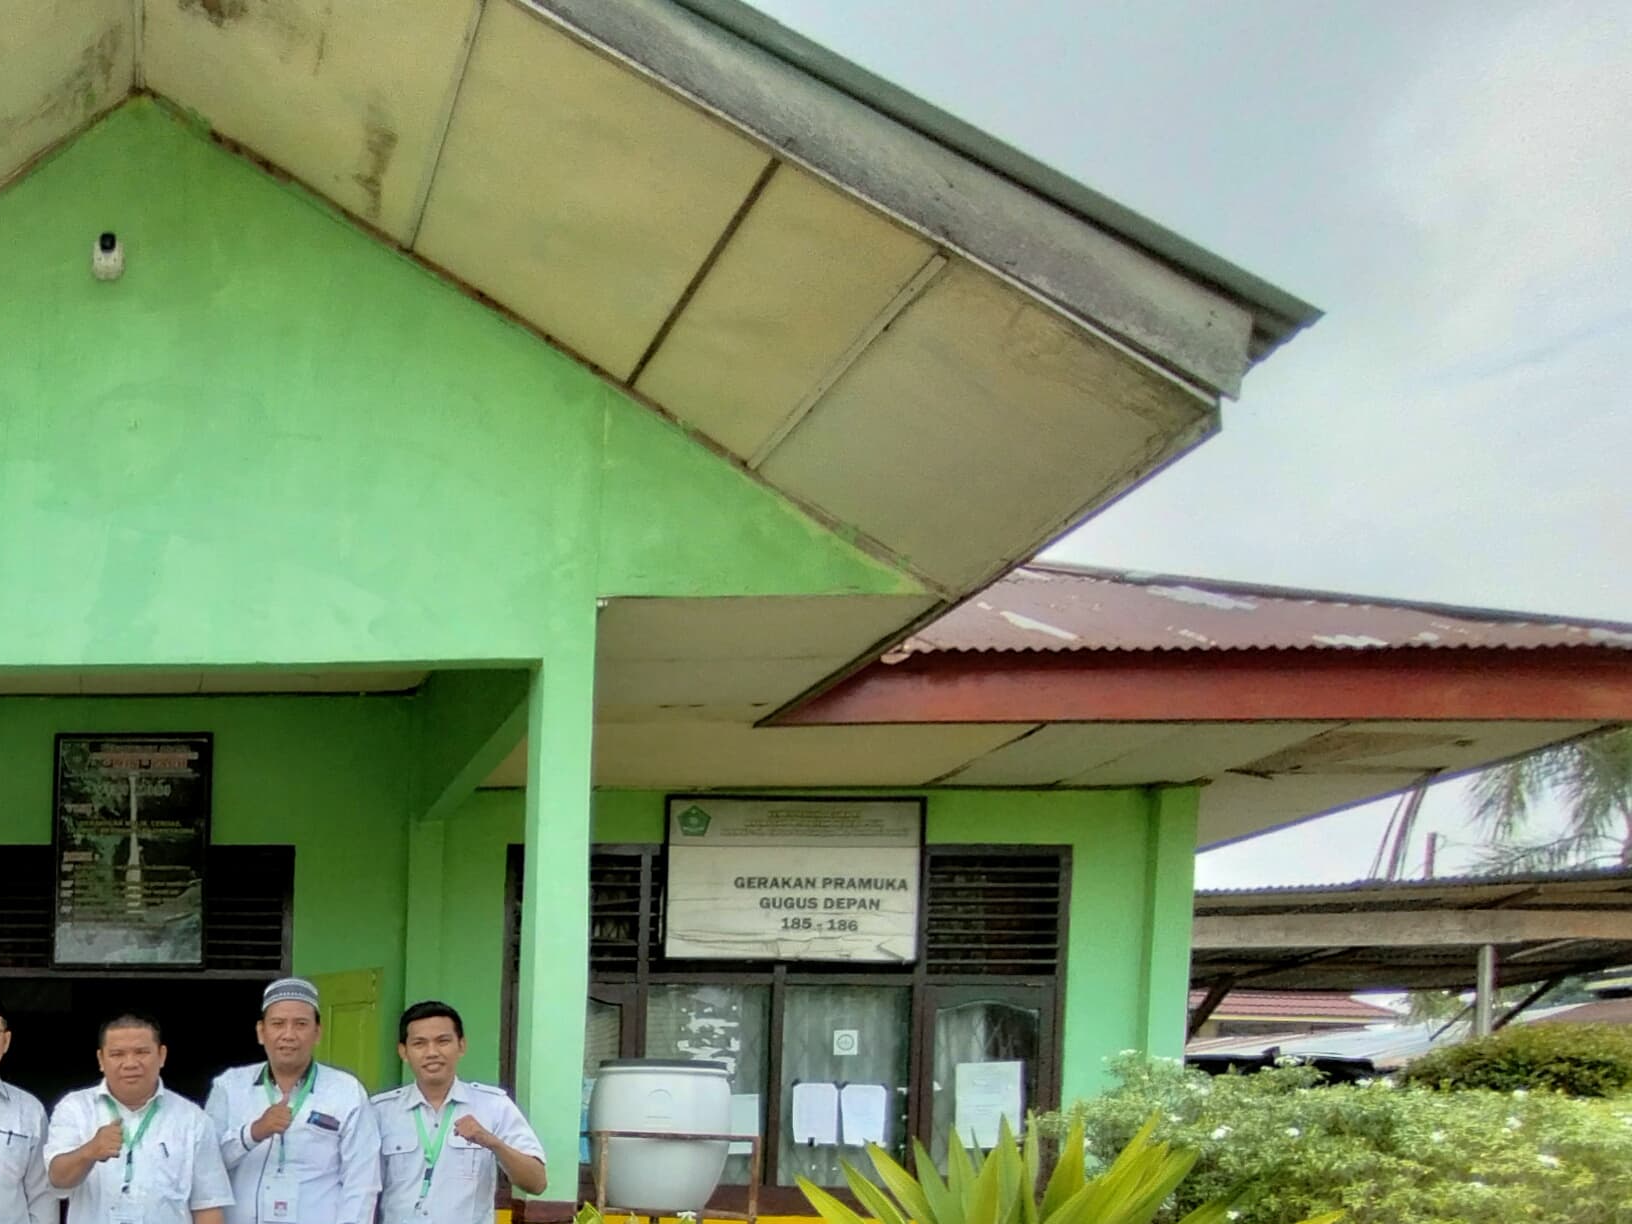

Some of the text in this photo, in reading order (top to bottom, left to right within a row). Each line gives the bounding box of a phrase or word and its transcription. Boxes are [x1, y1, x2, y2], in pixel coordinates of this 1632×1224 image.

[734, 876, 909, 892] GERAKAN PRAMUKA
[759, 897, 881, 911] GUGUS DEPAN
[781, 917, 812, 930] 185
[827, 918, 858, 932] 186
